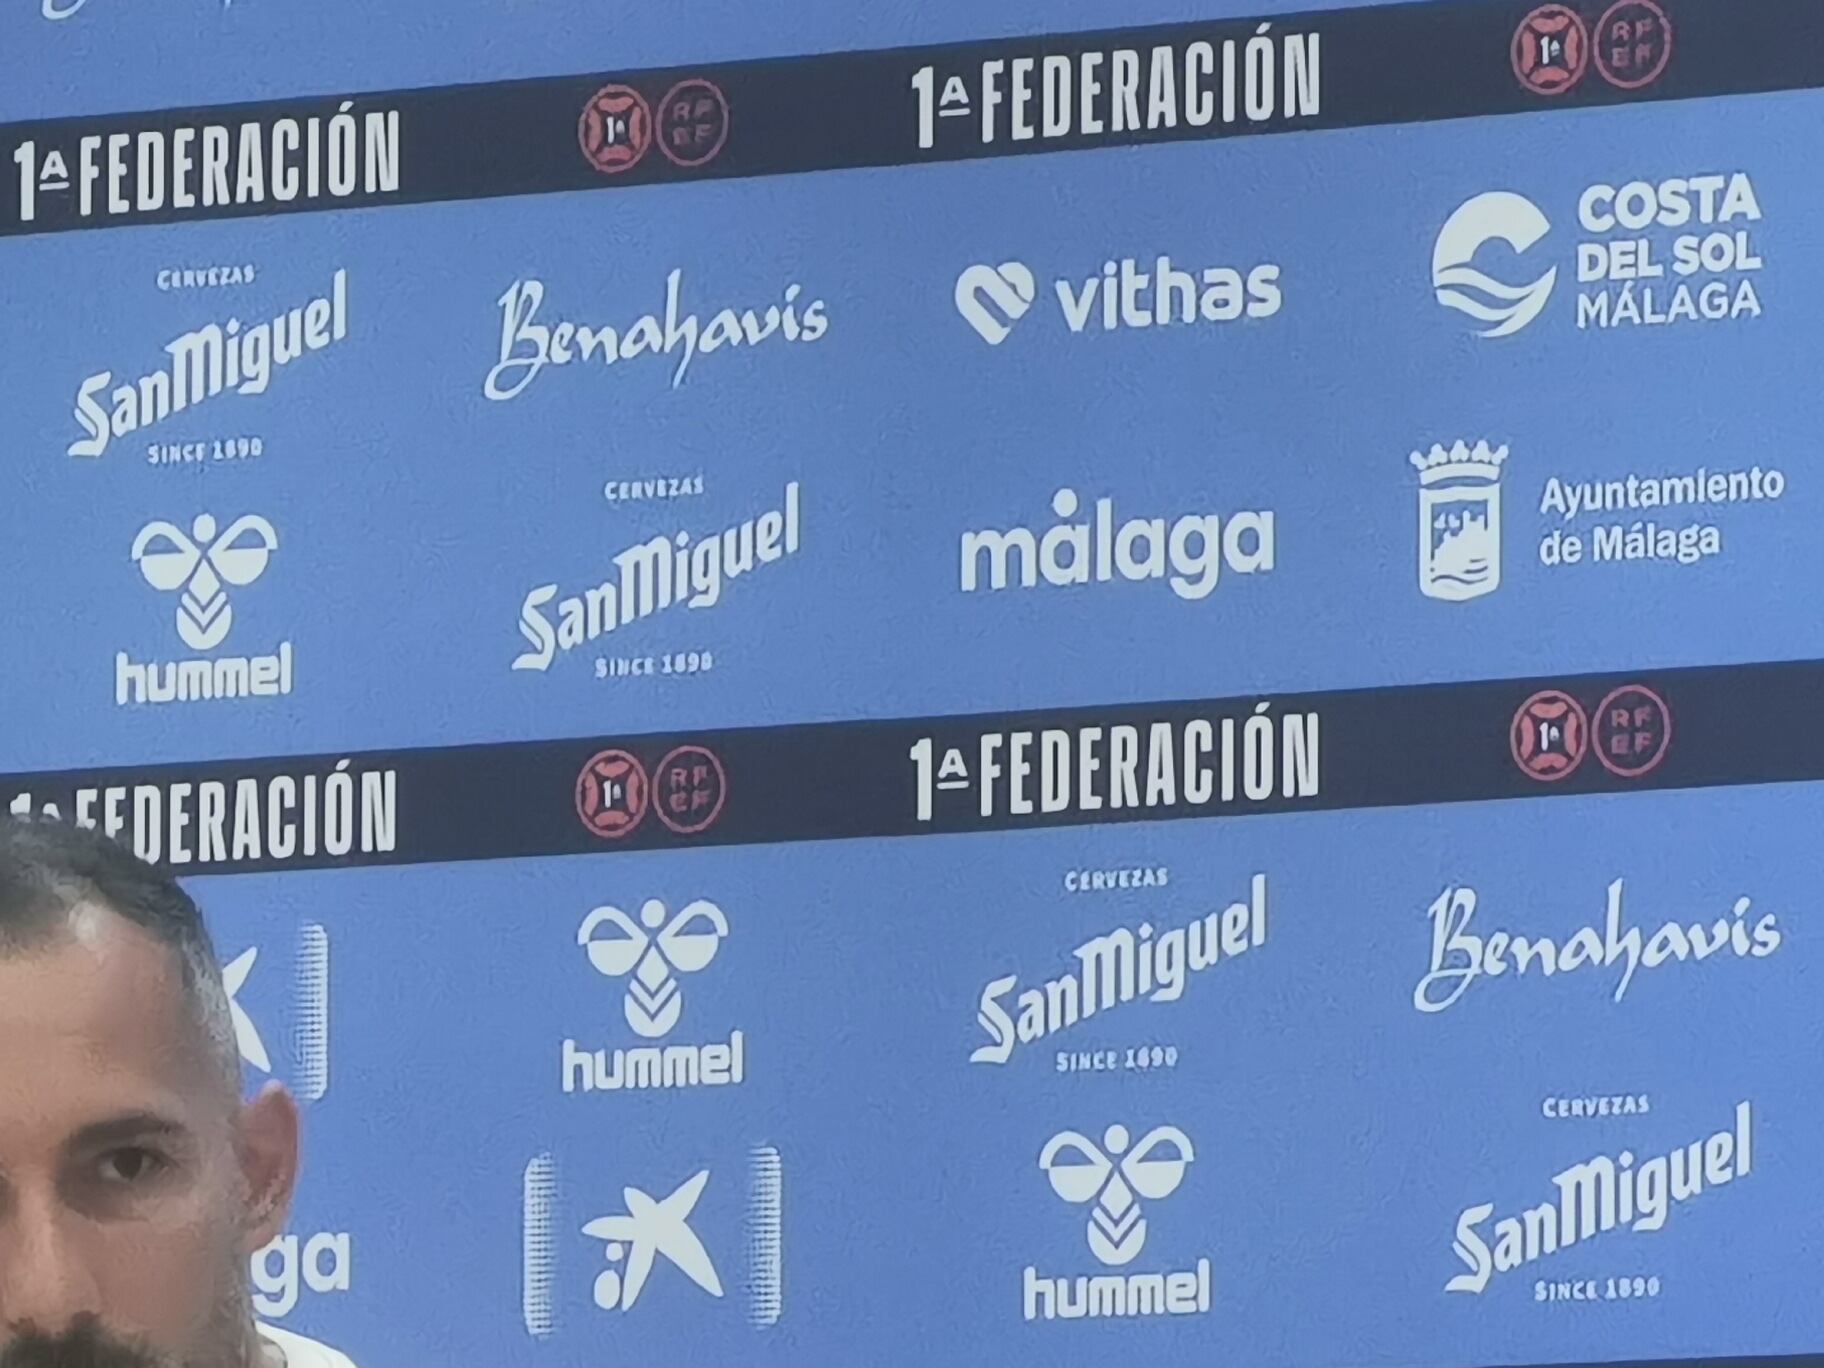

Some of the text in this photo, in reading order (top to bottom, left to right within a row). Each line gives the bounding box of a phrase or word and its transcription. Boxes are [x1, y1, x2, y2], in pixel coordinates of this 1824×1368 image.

[982, 22, 1320, 143] FEDERACIÓN
[80, 100, 399, 217] FEDERACIÓN
[1578, 172, 1762, 232] COSTA
[157, 264, 255, 291] CERVEZAS
[1577, 230, 1762, 285] DEL SOL
[1055, 256, 1282, 332] vithas
[1577, 274, 1761, 329] MÁLAGA
[148, 442, 206, 465] SINCE
[604, 475, 704, 500] CERVEZAS
[1540, 466, 1785, 521] Ayuntamiento
[1539, 521, 1720, 566] de Málaga
[116, 638, 292, 705] hummel
[980, 701, 1319, 817] FEDERACIÓN
[1064, 867, 1168, 892] CERVEZAS
[562, 1026, 743, 1092] hummel
[1056, 1050, 1117, 1072] SINCE
[1542, 1094, 1650, 1118] CERVEZAS
[1023, 1255, 1210, 1320] hummel
[1534, 1276, 1660, 1302] SINCE 1890
